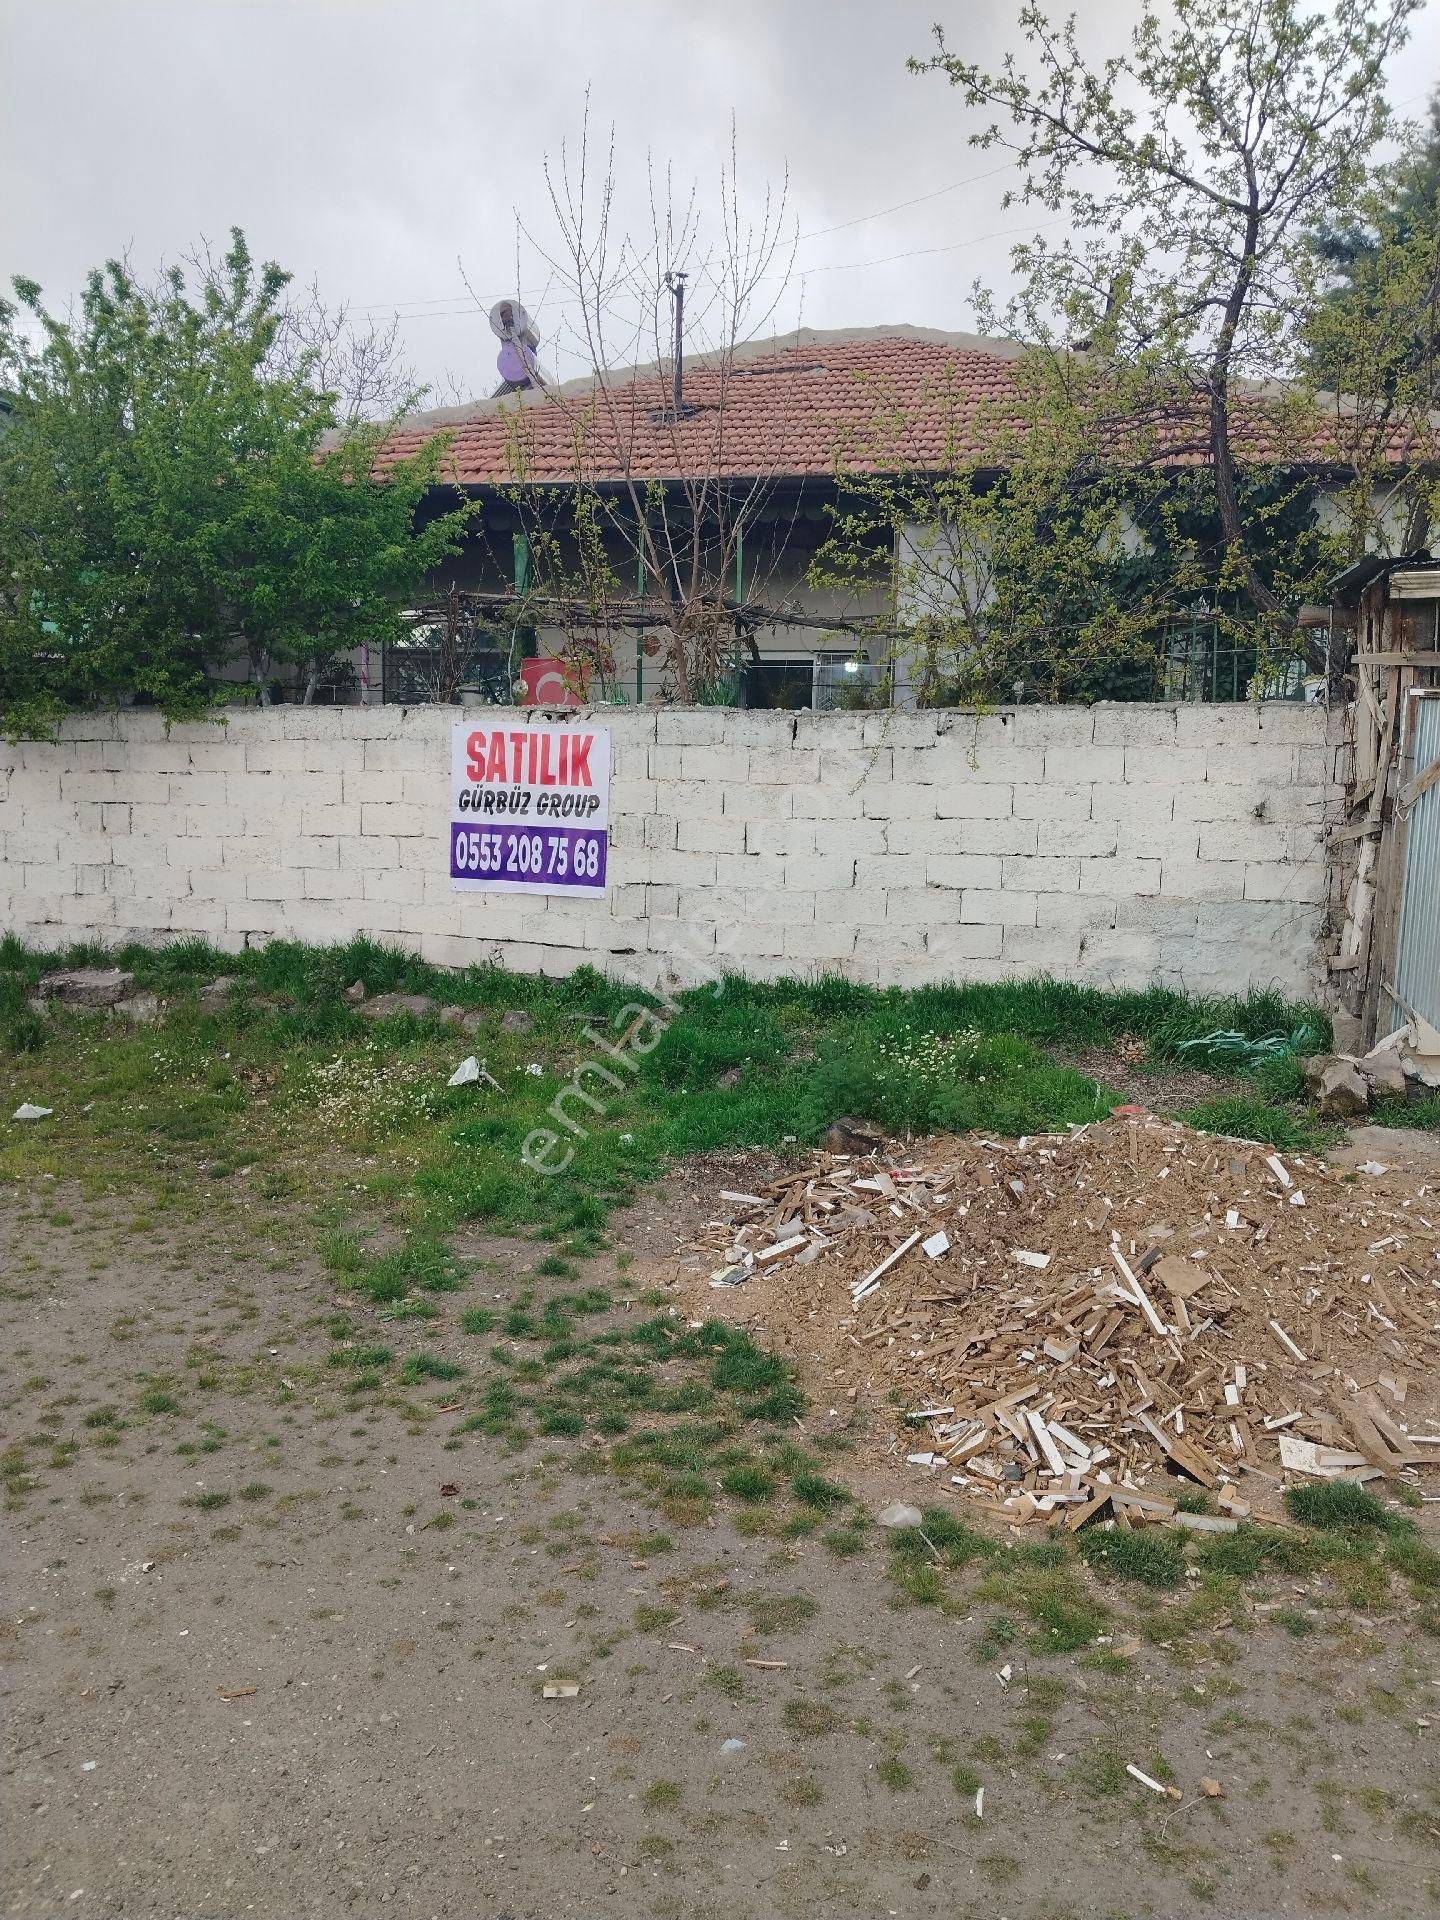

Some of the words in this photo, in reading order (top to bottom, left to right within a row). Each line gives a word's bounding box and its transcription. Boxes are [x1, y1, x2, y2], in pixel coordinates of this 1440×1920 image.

[466, 731, 594, 786] SATILIK
[458, 784, 531, 815] GÜRBÜZ
[536, 792, 600, 818] GROUP
[456, 831, 502, 871] 0553
[506, 834, 543, 873] 208
[547, 836, 569, 876] 75
[573, 838, 599, 877] 68
